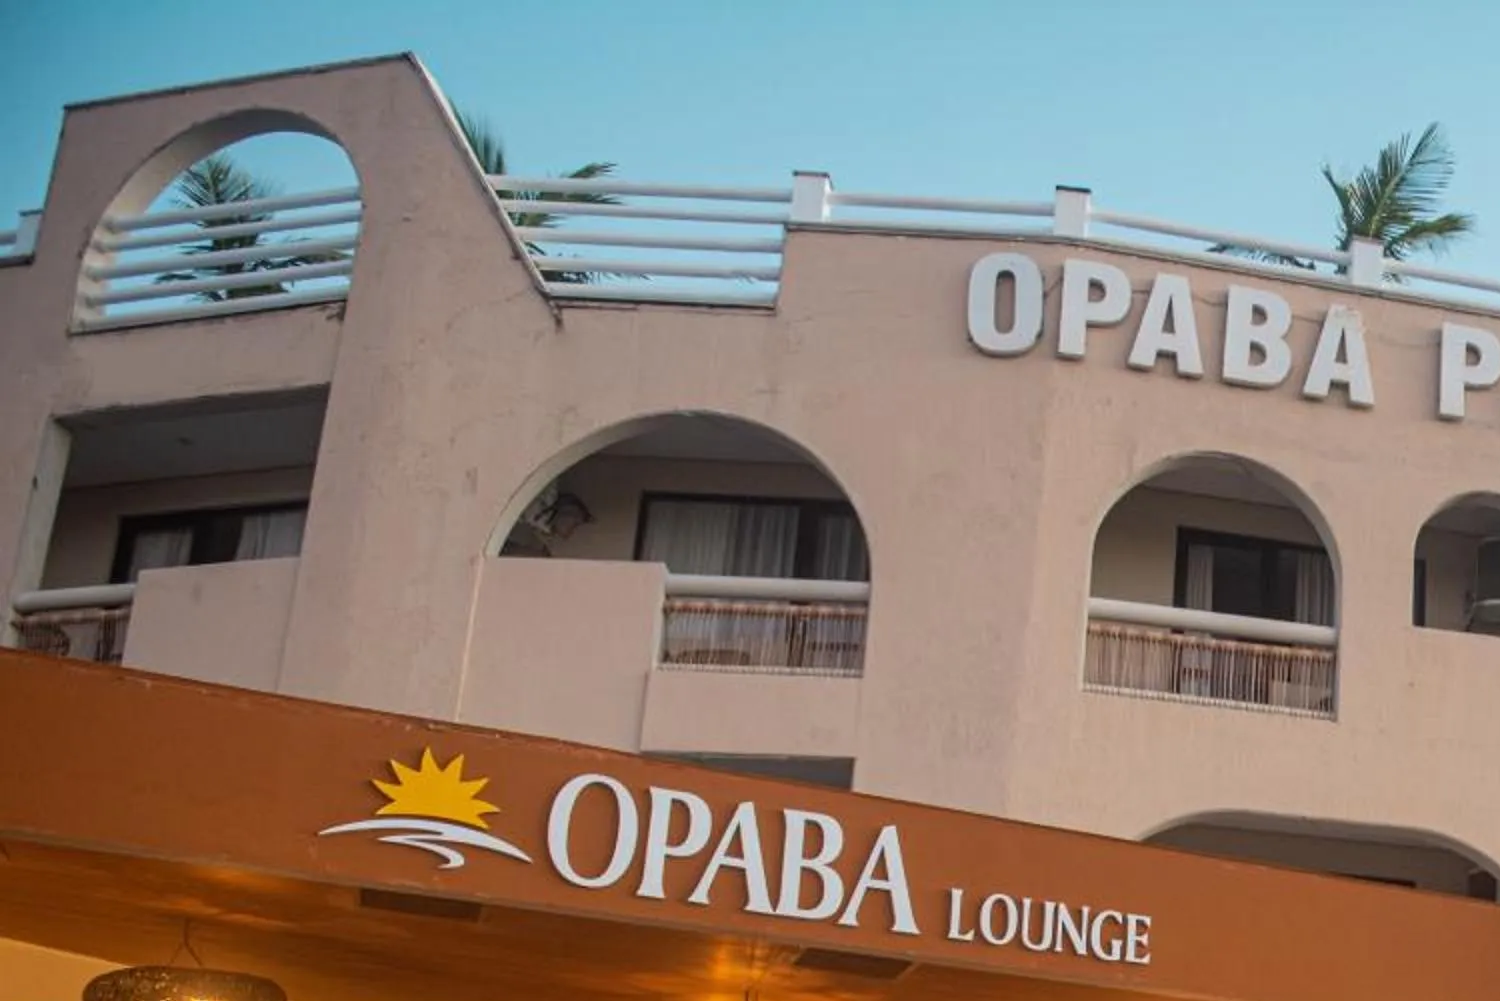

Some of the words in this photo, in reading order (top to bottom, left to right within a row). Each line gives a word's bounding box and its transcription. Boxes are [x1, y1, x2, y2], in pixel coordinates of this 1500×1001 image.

[967, 252, 1375, 409] OPABA
[547, 773, 920, 934] OPABA
[947, 887, 1152, 964] LOUNGE
